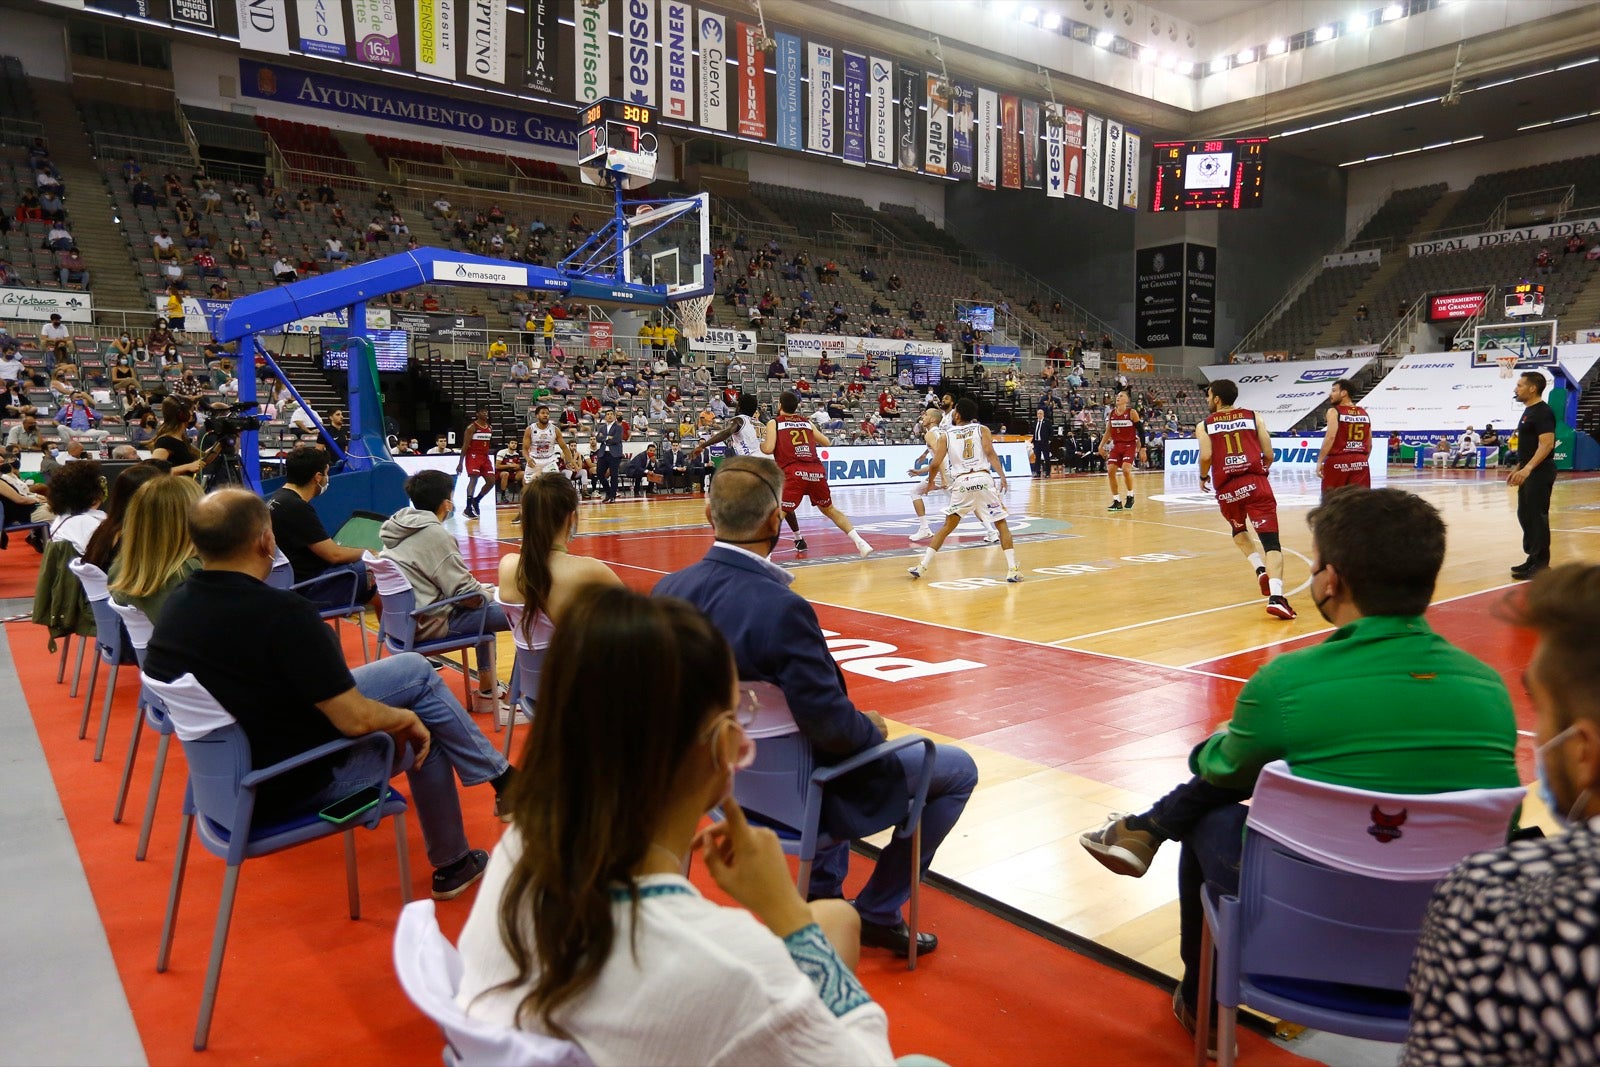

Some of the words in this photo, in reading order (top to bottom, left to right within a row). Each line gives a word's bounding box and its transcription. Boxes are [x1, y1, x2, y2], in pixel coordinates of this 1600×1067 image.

[249, 0, 275, 33] ND
[314, 0, 328, 36] ANO
[356, 0, 367, 23] rtes
[537, 0, 545, 25] EL
[420, 0, 434, 64] CENSORES
[441, 1, 450, 50] desur
[367, 42, 390, 56] 16h
[536, 29, 545, 72] LUNA
[583, 10, 601, 100] fertisac
[669, 5, 685, 93] BERNER
[788, 41, 797, 54] LA
[527, 83, 552, 93] GRANADA
[709, 48, 722, 107] Cuerva
[297, 77, 484, 129] AYUNTAMIENTO
[490, 117, 518, 136] DE
[525, 117, 579, 145] GRAN
[747, 79, 758, 120] LUNA
[624, 105, 649, 123] 3:08
[878, 86, 886, 159] emasagra
[929, 121, 946, 164] enPie
[1050, 126, 1060, 172] sisa
[1414, 238, 1469, 256] IDEAL
[1478, 228, 1539, 247] IDEAL
[1548, 219, 1600, 238] IDEA
[467, 269, 506, 281] emasagra
[544, 279, 568, 287] MONDO
[612, 291, 634, 299] MONDO
[1435, 295, 1482, 305] AYUNTAMIENTO
[1447, 303, 1478, 311] GRANADA
[1303, 368, 1346, 378] PULEVA
[1276, 391, 1318, 399] asisa
[789, 429, 809, 446] 21
[1214, 421, 1247, 431] PULEVA
[1347, 423, 1365, 441] 15
[1223, 432, 1243, 454] 11
